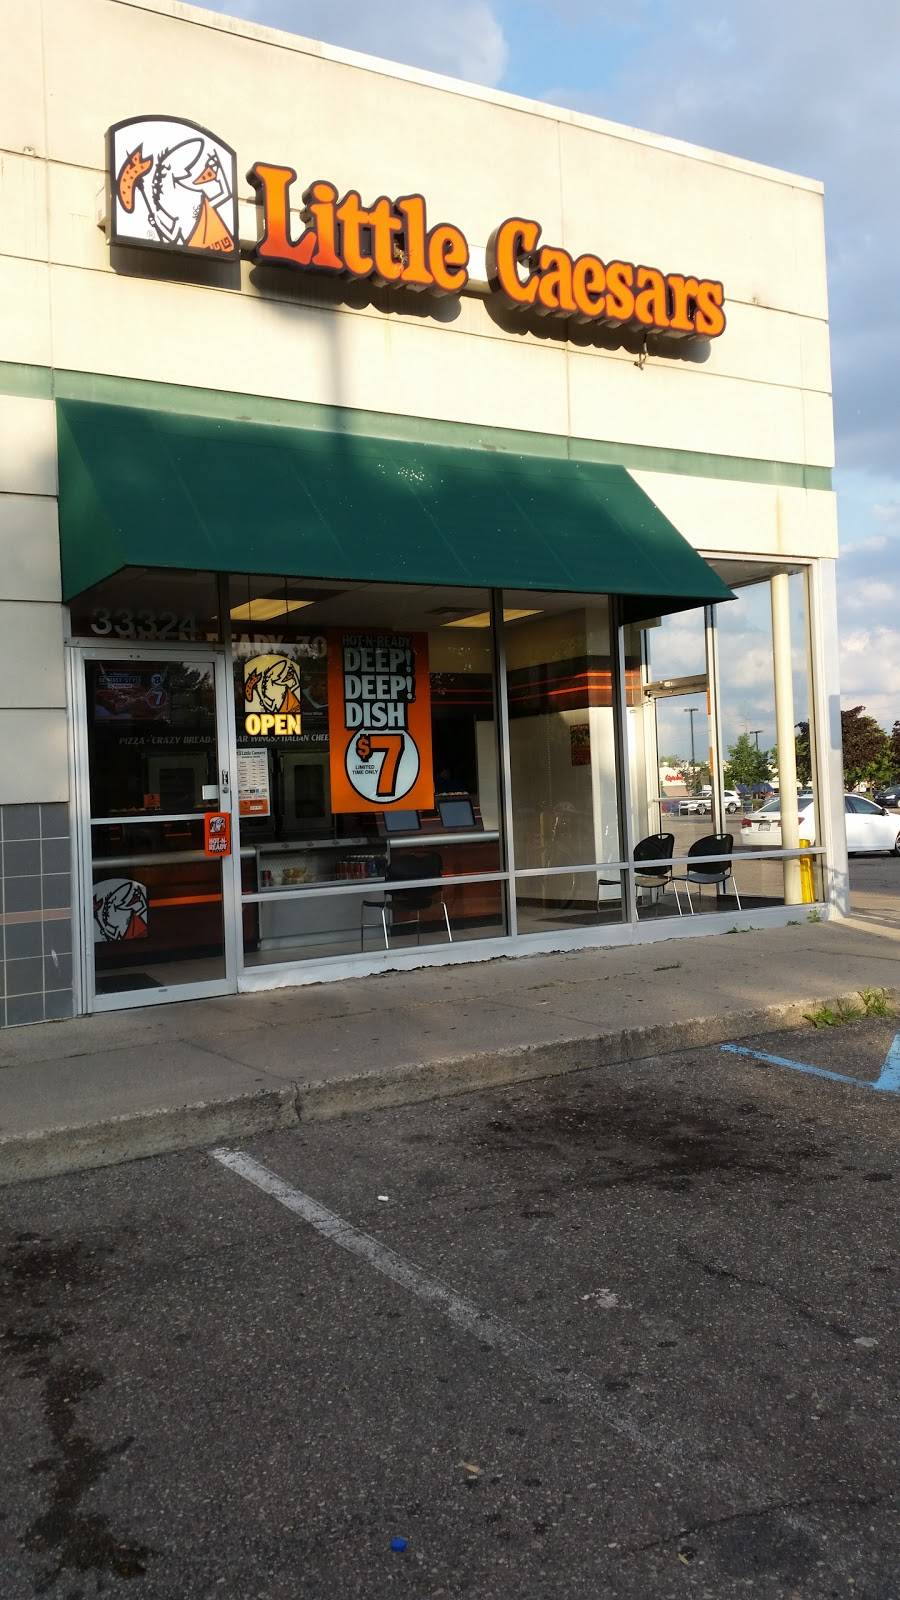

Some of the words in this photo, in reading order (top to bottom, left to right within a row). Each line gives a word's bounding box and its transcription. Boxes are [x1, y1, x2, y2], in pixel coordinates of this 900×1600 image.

[254, 161, 470, 293] Little
[494, 216, 726, 338] Caesars
[90, 608, 197, 638] 33324
[343, 635, 410, 648] HOT-N-READY
[344, 647, 412, 674] DEEP!
[345, 673, 413, 701] DEEP!
[245, 712, 303, 736] OPEN
[345, 702, 405, 729] DISH
[151, 736, 182, 745] CRAZY
